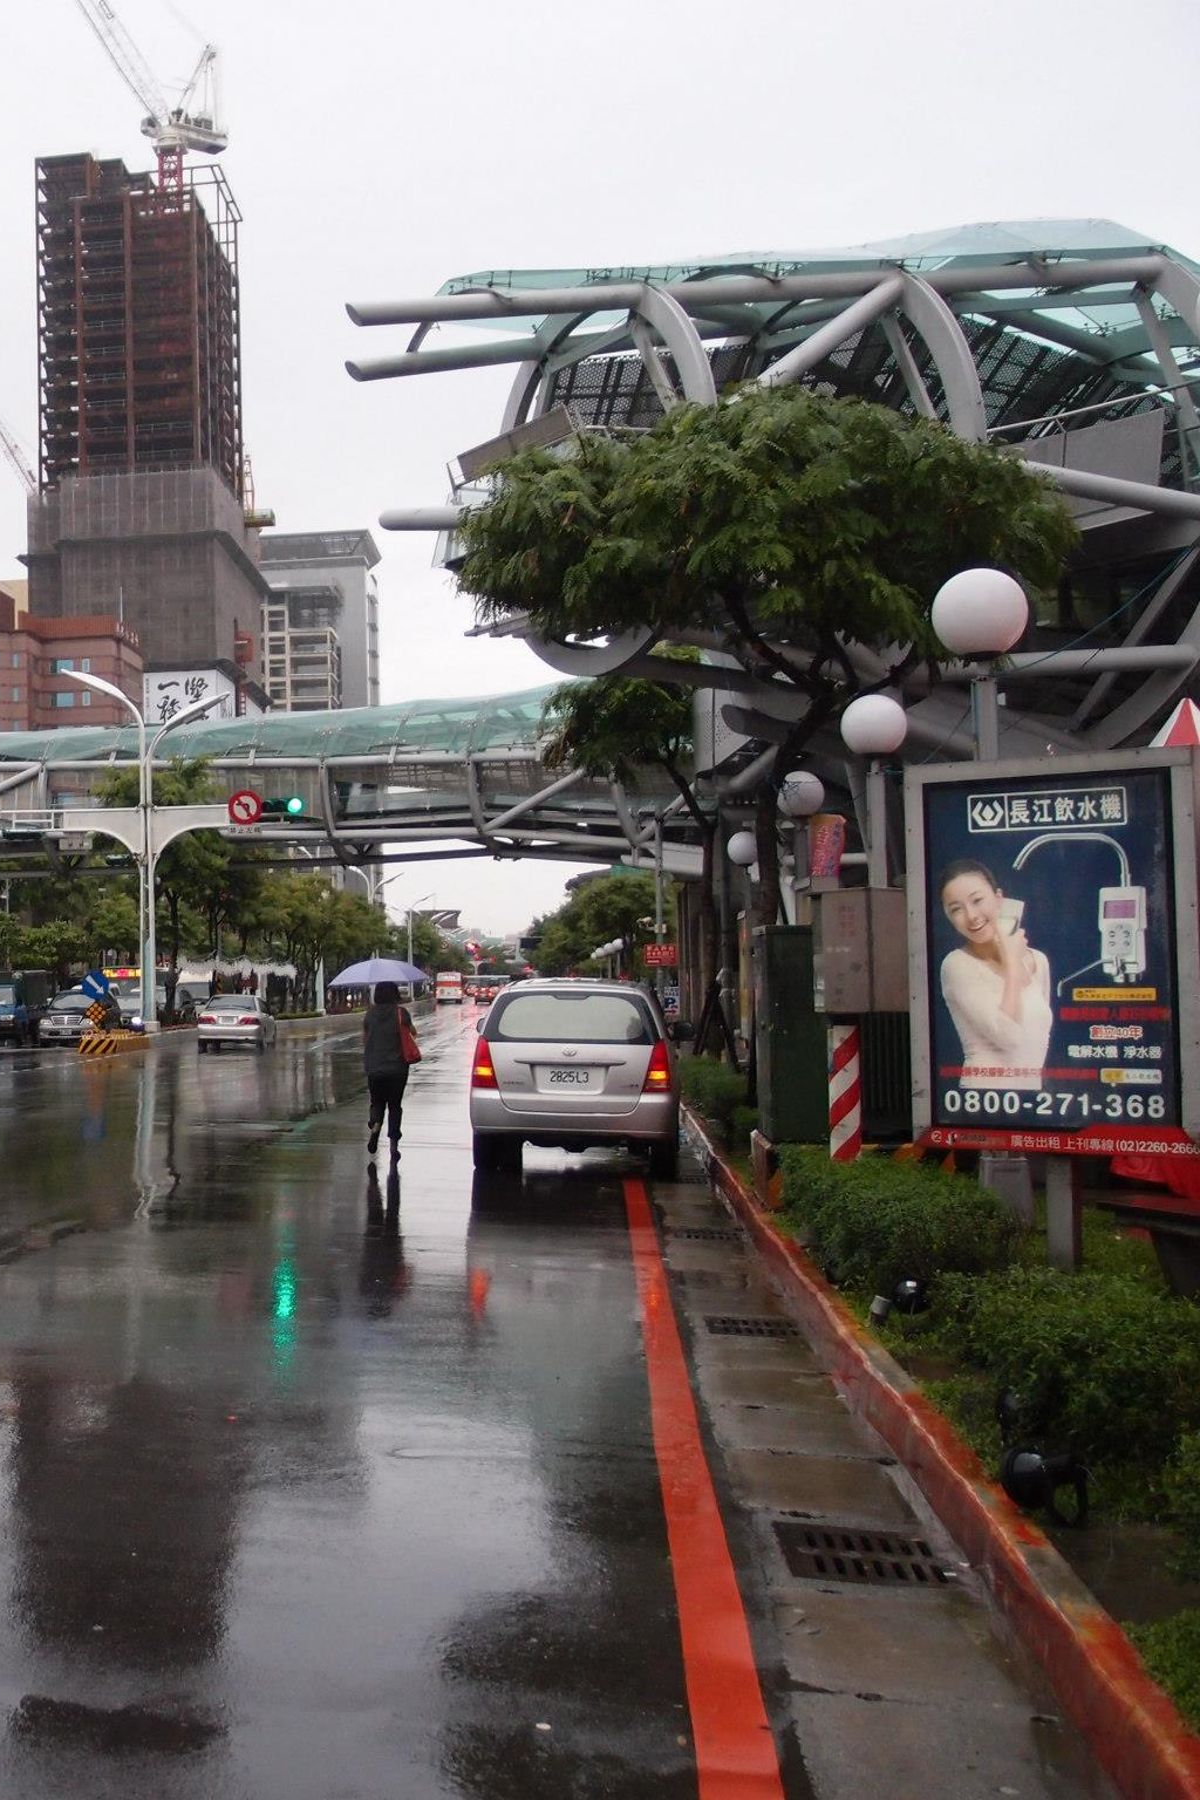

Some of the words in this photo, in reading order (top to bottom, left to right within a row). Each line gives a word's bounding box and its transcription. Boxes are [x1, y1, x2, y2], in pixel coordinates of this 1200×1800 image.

[1010, 794, 1122, 824] 長江飲水機
[944, 1090, 1166, 1118] 0800-271-368
[1011, 1134, 1061, 1149] 廣告出租
